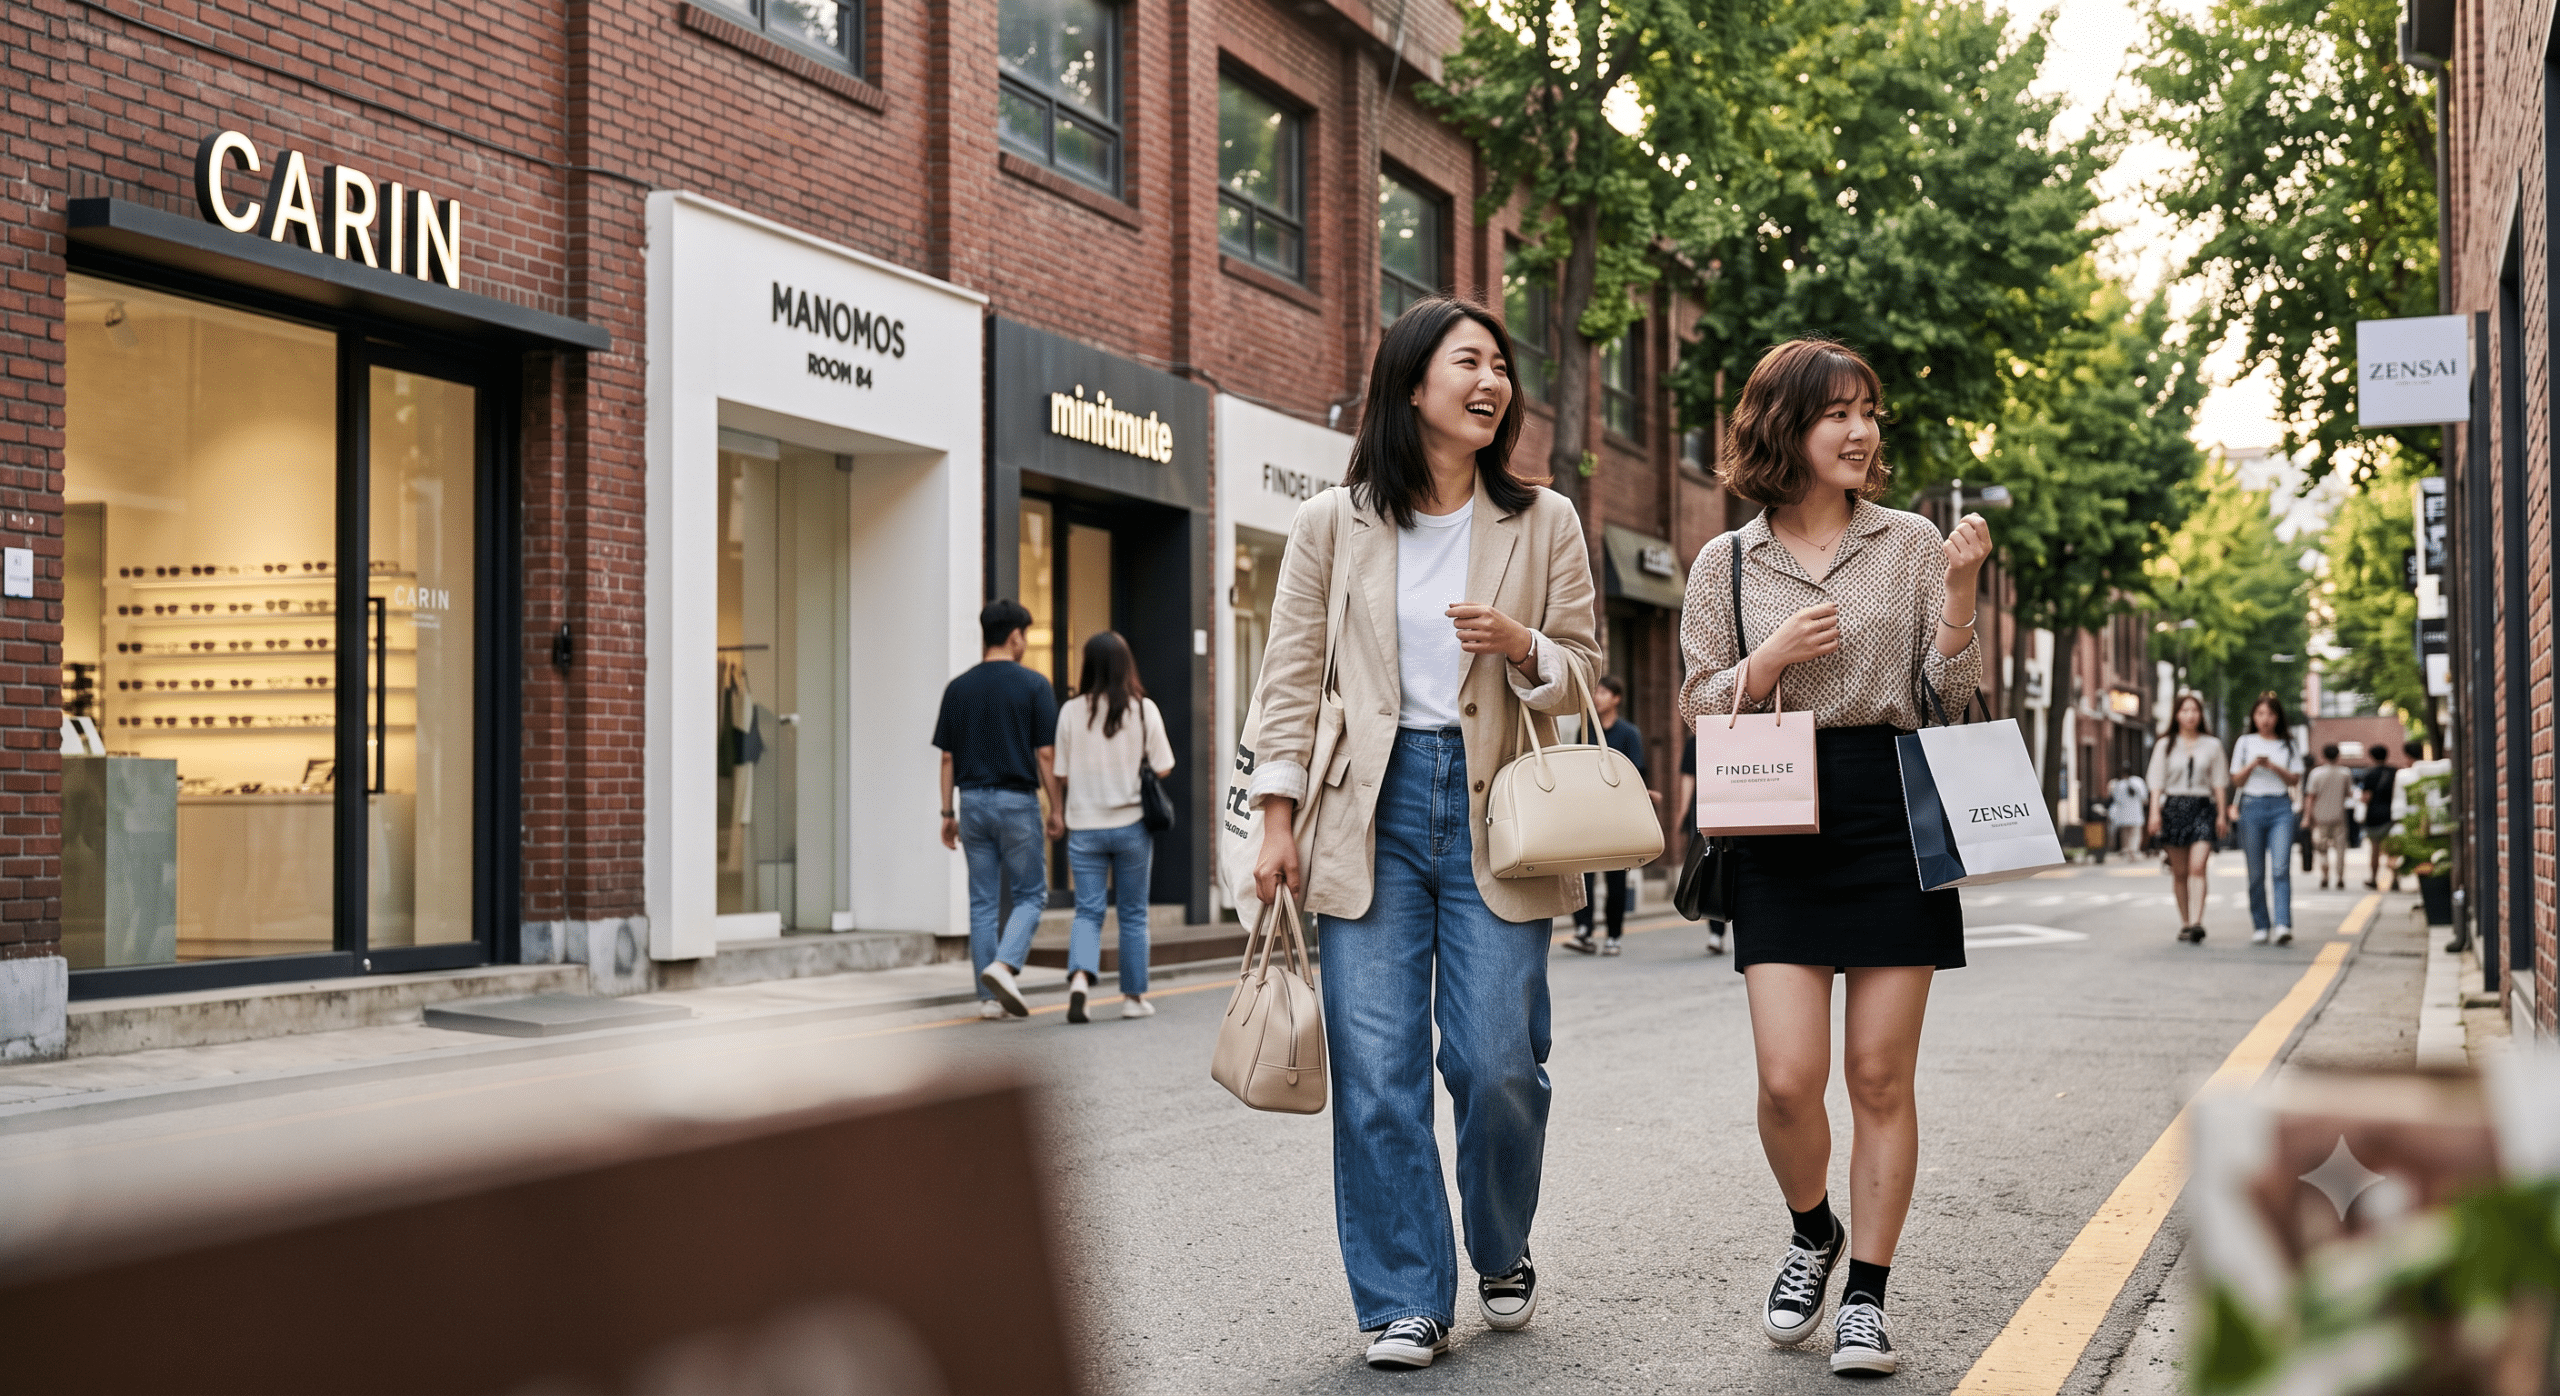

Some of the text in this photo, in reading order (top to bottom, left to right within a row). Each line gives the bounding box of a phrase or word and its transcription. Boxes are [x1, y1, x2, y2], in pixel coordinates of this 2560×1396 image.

[200, 130, 461, 290] CARIN
[772, 281, 905, 359] MANOMOS
[808, 352, 851, 384] ROOM
[2369, 358, 2456, 381] ZENSAI
[1051, 383, 1173, 464] minitmute
[1263, 463, 1337, 501] FINDELI
[394, 585, 450, 610] CARIN
[1716, 762, 1794, 776] FINDELISE
[1968, 802, 2030, 823] ZENSAI
